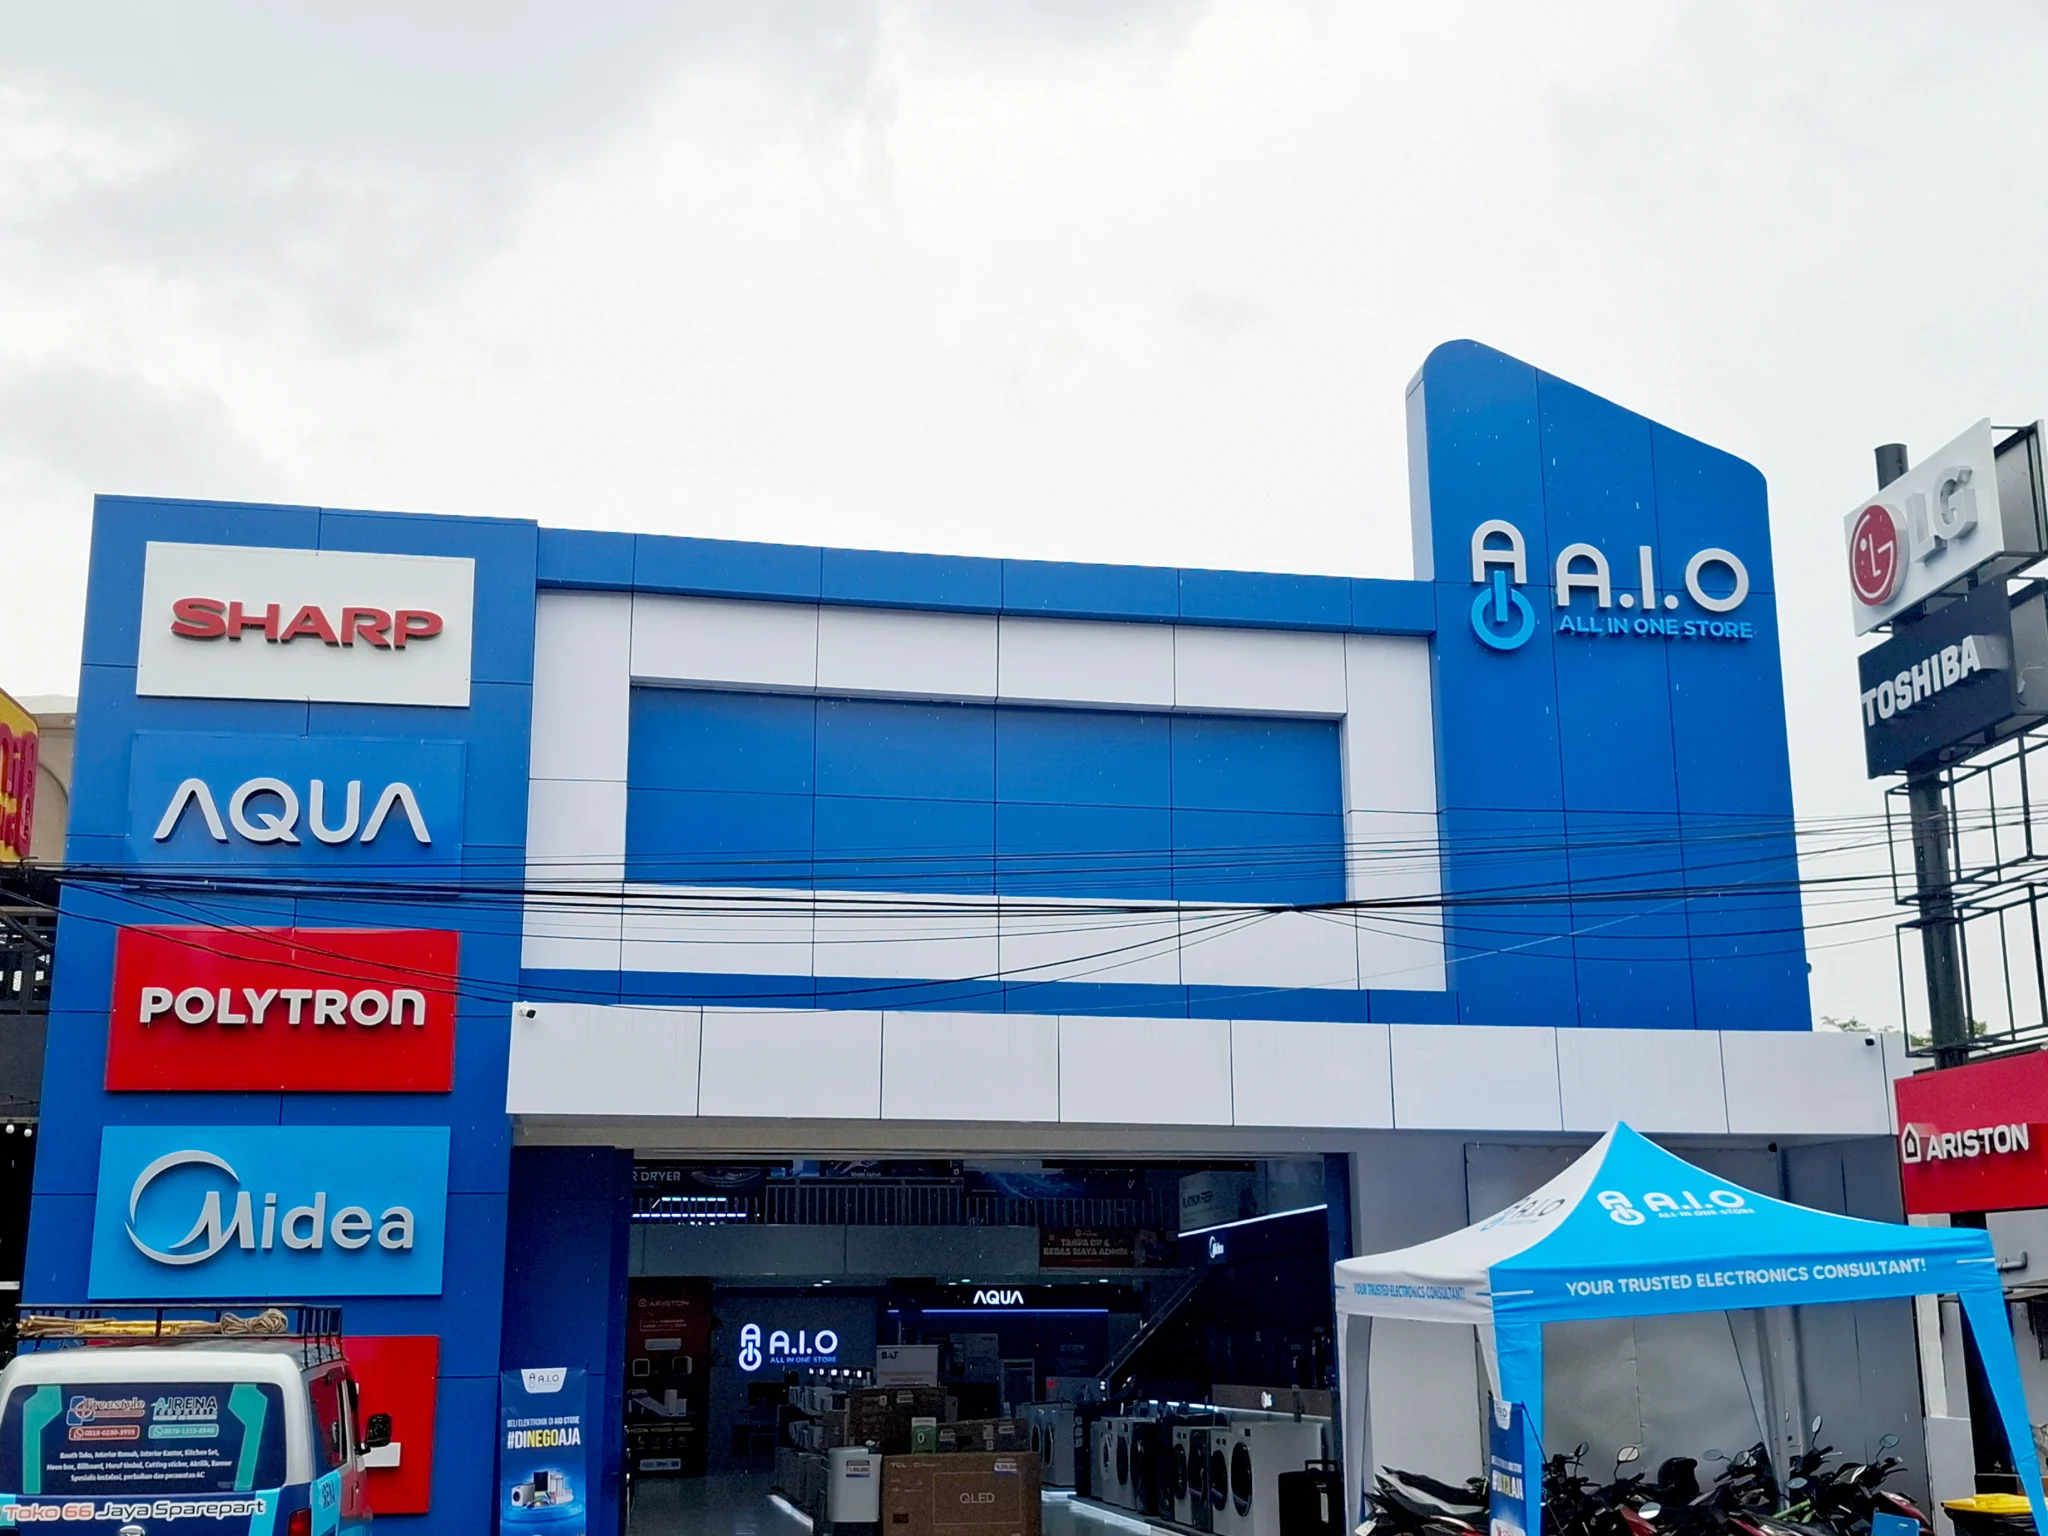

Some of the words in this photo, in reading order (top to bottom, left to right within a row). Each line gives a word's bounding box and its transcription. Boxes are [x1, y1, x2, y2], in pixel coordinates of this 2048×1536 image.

[1906, 465, 1979, 563] LG
[1556, 543, 1749, 612] A.I.O
[170, 597, 444, 650] SHARP
[1558, 614, 1602, 633] ALL
[1608, 617, 1628, 634] IN
[1634, 618, 1679, 636] ONE
[1684, 620, 1754, 639] STORE
[1861, 635, 1983, 726] TOSHIBA
[153, 777, 432, 844] AQUA
[139, 986, 427, 1027] POLYTRON
[1926, 1122, 2029, 1161] ARISTON
[641, 1171, 681, 1181] DRYER
[1643, 1190, 1745, 1211] A.I.O
[168, 1190, 415, 1250] Midea
[1565, 1279, 1615, 1296] YOUR
[1618, 1274, 1692, 1293] TRUSTED
[1696, 1266, 1809, 1288] ELECTRONICS
[1812, 1257, 1927, 1280] CONSULTANT!
[973, 1290, 1024, 1305] AQUA
[1354, 1283, 1367, 1295] YOUR
[1368, 1283, 1389, 1296] TRUSTED
[1390, 1285, 1425, 1298] ELECTRONICS
[769, 1329, 838, 1355] A.I.O
[770, 1356, 785, 1364] ALL
[507, 1427, 581, 1449] #DINEGOAJA
[184, 1449, 207, 1457] Kitchen
[4, 1506, 62, 1521] Toko
[64, 1505, 93, 1520] 66
[97, 1503, 150, 1521] Jaya
[155, 1500, 266, 1520] Sparepart
[960, 1492, 995, 1504] QLED
